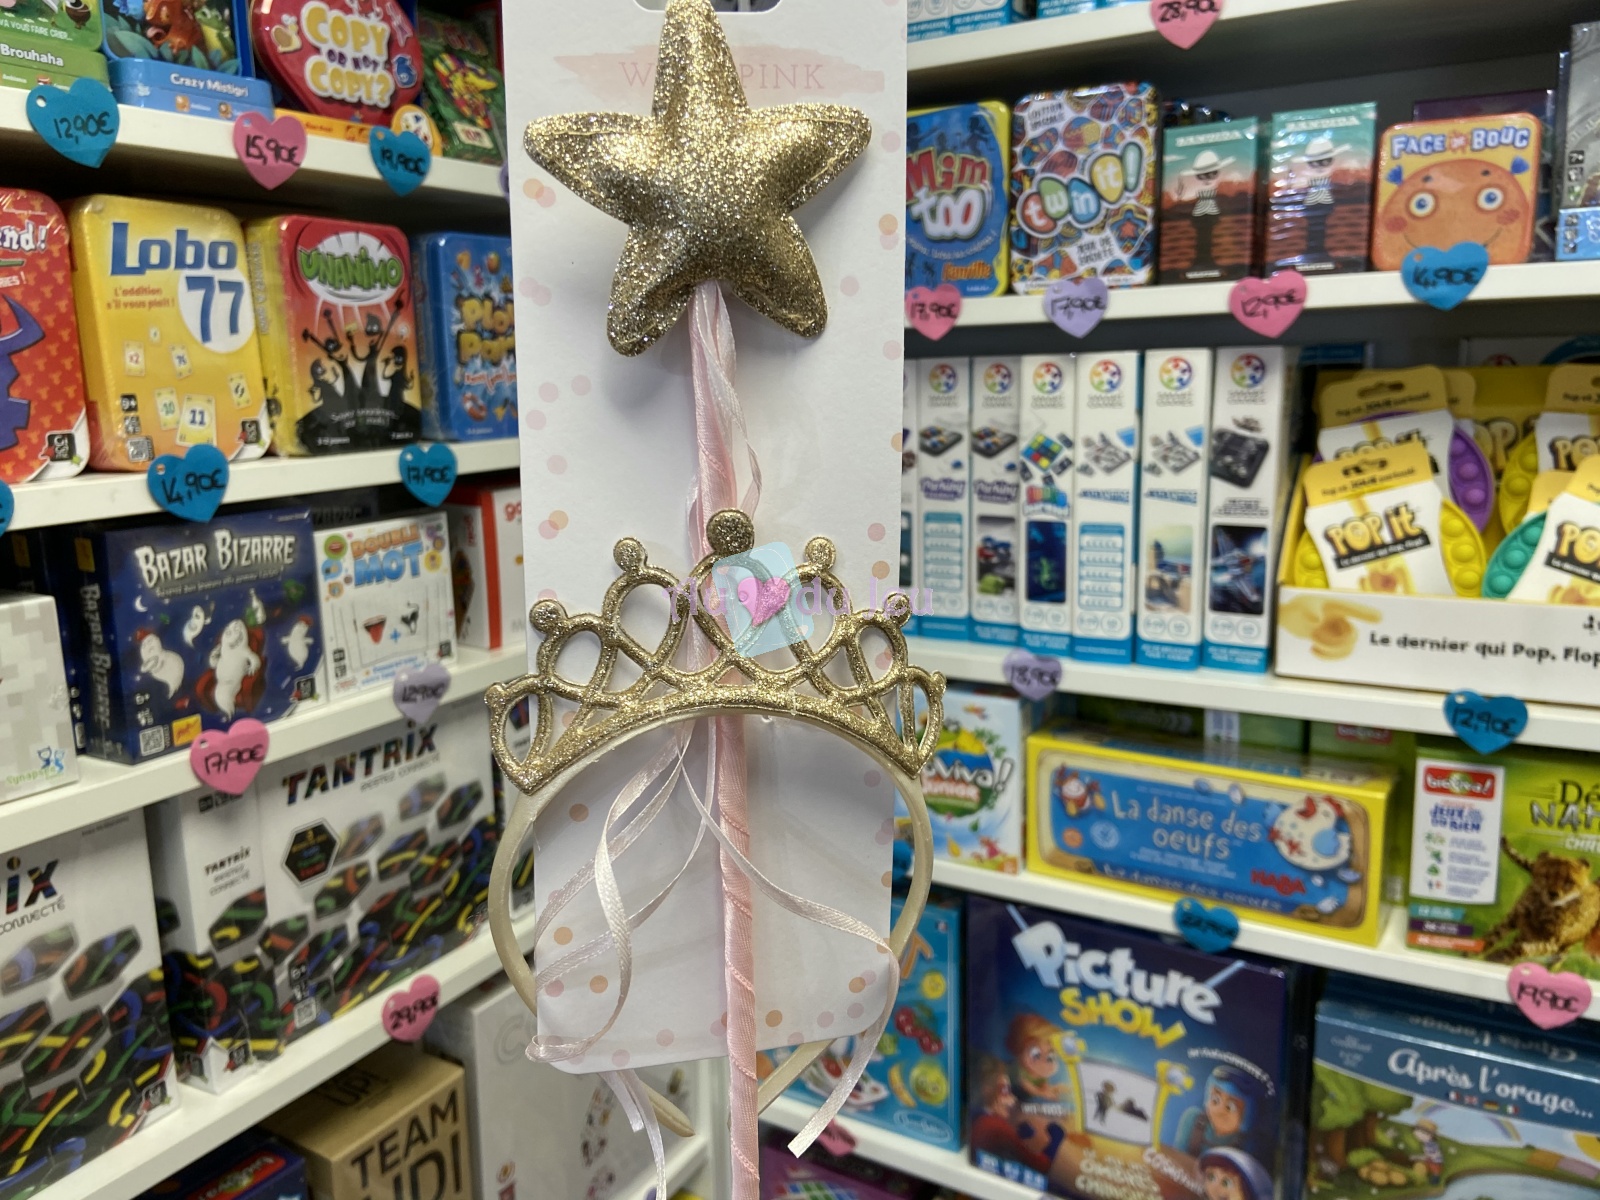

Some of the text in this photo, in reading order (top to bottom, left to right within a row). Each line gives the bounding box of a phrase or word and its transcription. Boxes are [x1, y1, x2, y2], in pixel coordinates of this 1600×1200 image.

[10, 21, 30, 32] VOUS
[30, 25, 49, 37] FAIRE
[302, 2, 391, 58] COPY
[1, 43, 65, 67] Brouhaha
[326, 49, 347, 67] OR
[170, 73, 249, 98] Crazy Mistigri
[307, 58, 394, 106] COPY?
[740, 62, 825, 90] PINK
[54, 112, 115, 144] 12,90€
[1391, 133, 1447, 159] FACE
[1470, 127, 1531, 152] BOUC
[245, 134, 300, 165] 15,90€
[110, 222, 238, 276] Lobo
[185, 275, 245, 344] 77
[351, 523, 420, 561] DOUBLE
[1325, 503, 1423, 556] POP it
[134, 543, 208, 588] BAZAR
[213, 528, 297, 571] BIZARRE
[354, 542, 424, 588] MOT
[1370, 631, 1392, 646] Le
[1397, 633, 1469, 652] dernier
[1475, 640, 1506, 658] qui
[1452, 708, 1517, 737] 12,90€
[1111, 790, 1261, 842] La danse des
[1152, 827, 1231, 860] oeufs
[1251, 869, 1306, 896] HABA
[1011, 920, 1222, 1024] Picture
[1517, 982, 1580, 1013] 19,90€
[1059, 986, 1187, 1049] SHOW
[1387, 1048, 1474, 1089] Après
[350, 1088, 459, 1189] TEAM
